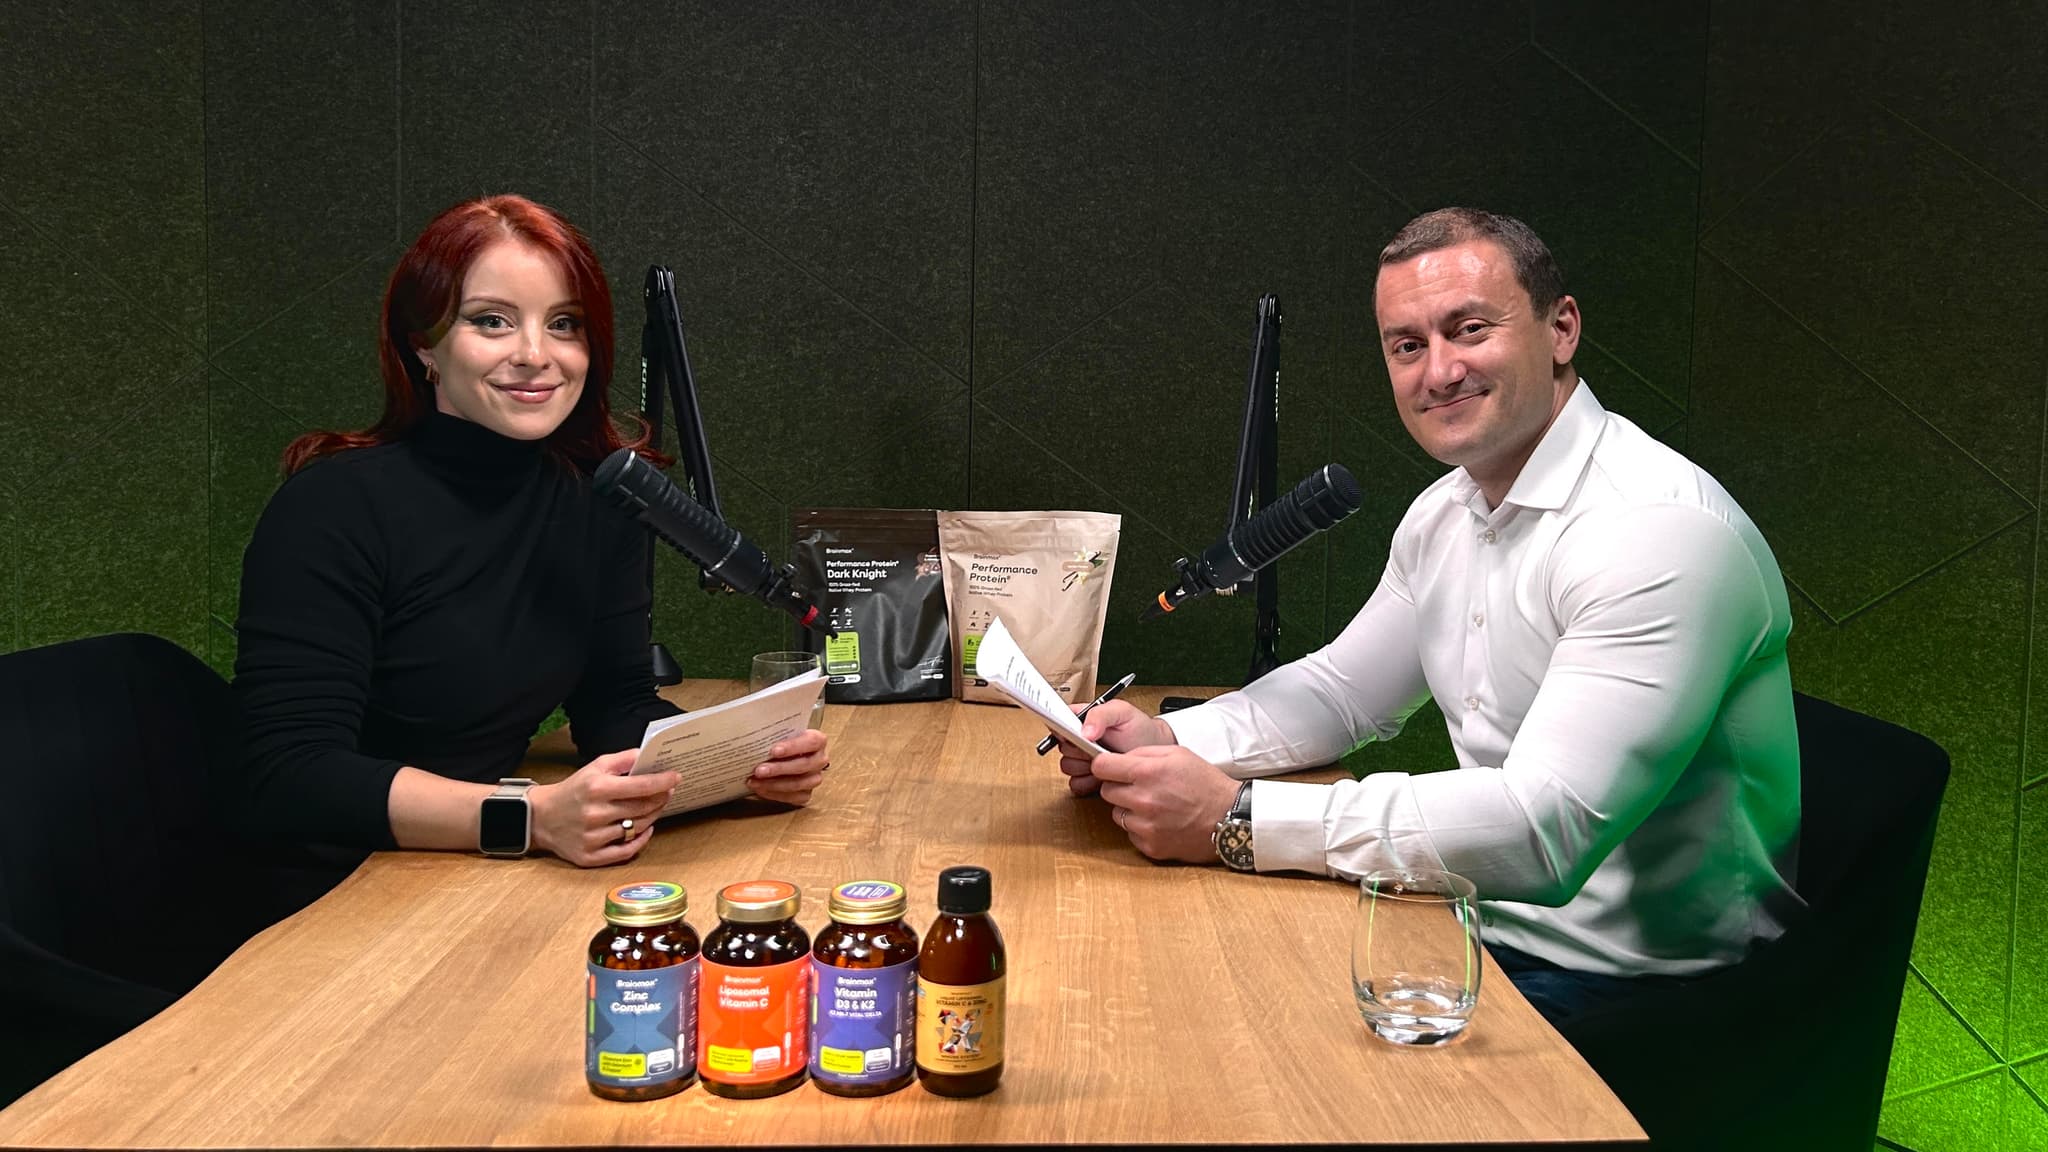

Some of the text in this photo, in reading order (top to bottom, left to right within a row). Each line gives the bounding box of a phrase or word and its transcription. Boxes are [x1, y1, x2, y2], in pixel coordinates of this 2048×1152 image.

[827, 569, 887, 580] Dark Knight
[971, 563, 1038, 575] Performance
[623, 990, 648, 1001] Zinc
[719, 985, 770, 997] Liposomal
[834, 987, 877, 998] Vitamin
[719, 997, 769, 1008] Vitamin C
[836, 999, 875, 1010] D3 & K2
[610, 1002, 662, 1015] Complex
